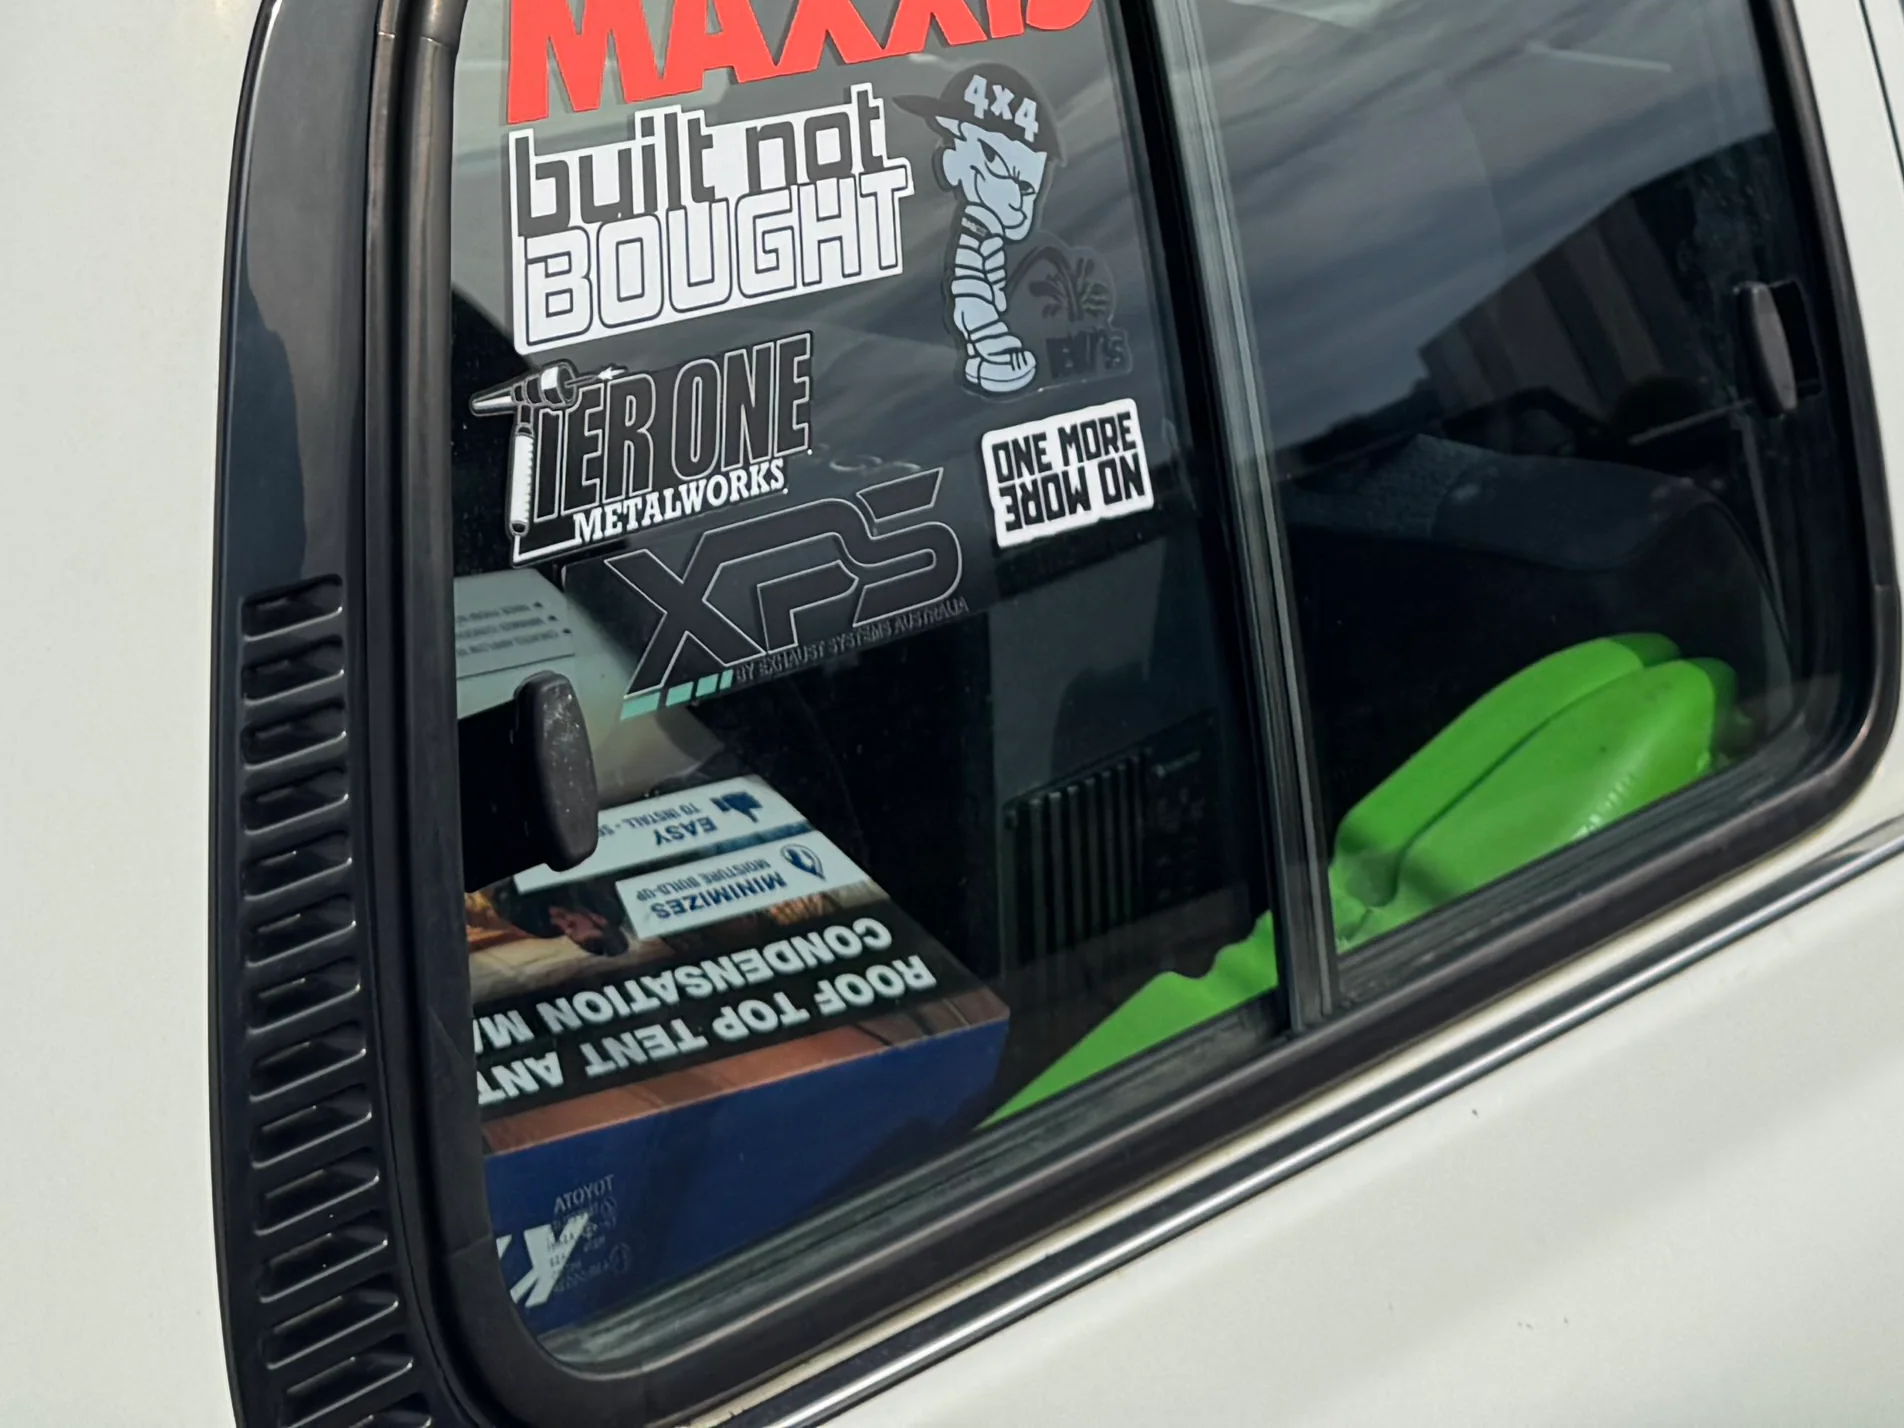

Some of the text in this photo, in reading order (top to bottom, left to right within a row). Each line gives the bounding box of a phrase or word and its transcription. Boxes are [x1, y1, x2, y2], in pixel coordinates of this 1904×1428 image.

[515, 89, 886, 237] built not
[523, 165, 910, 347] BOUGHT
[670, 332, 813, 480] ONE
[991, 410, 1137, 484] ONE MORE
[572, 458, 786, 544] METALWORKS
[998, 451, 1146, 533] NO MORE
[603, 467, 963, 700] XPS
[624, 805, 683, 830] INSTALL
[653, 815, 718, 847] EASY
[682, 801, 701, 818] TO
[649, 871, 788, 920] MINIMIZES
[698, 858, 771, 887] MOISTURE
[536, 916, 893, 1035] CONDENSATION
[813, 953, 938, 1016] ROOF
[583, 1017, 710, 1079] TENT
[710, 990, 811, 1041] TOP
